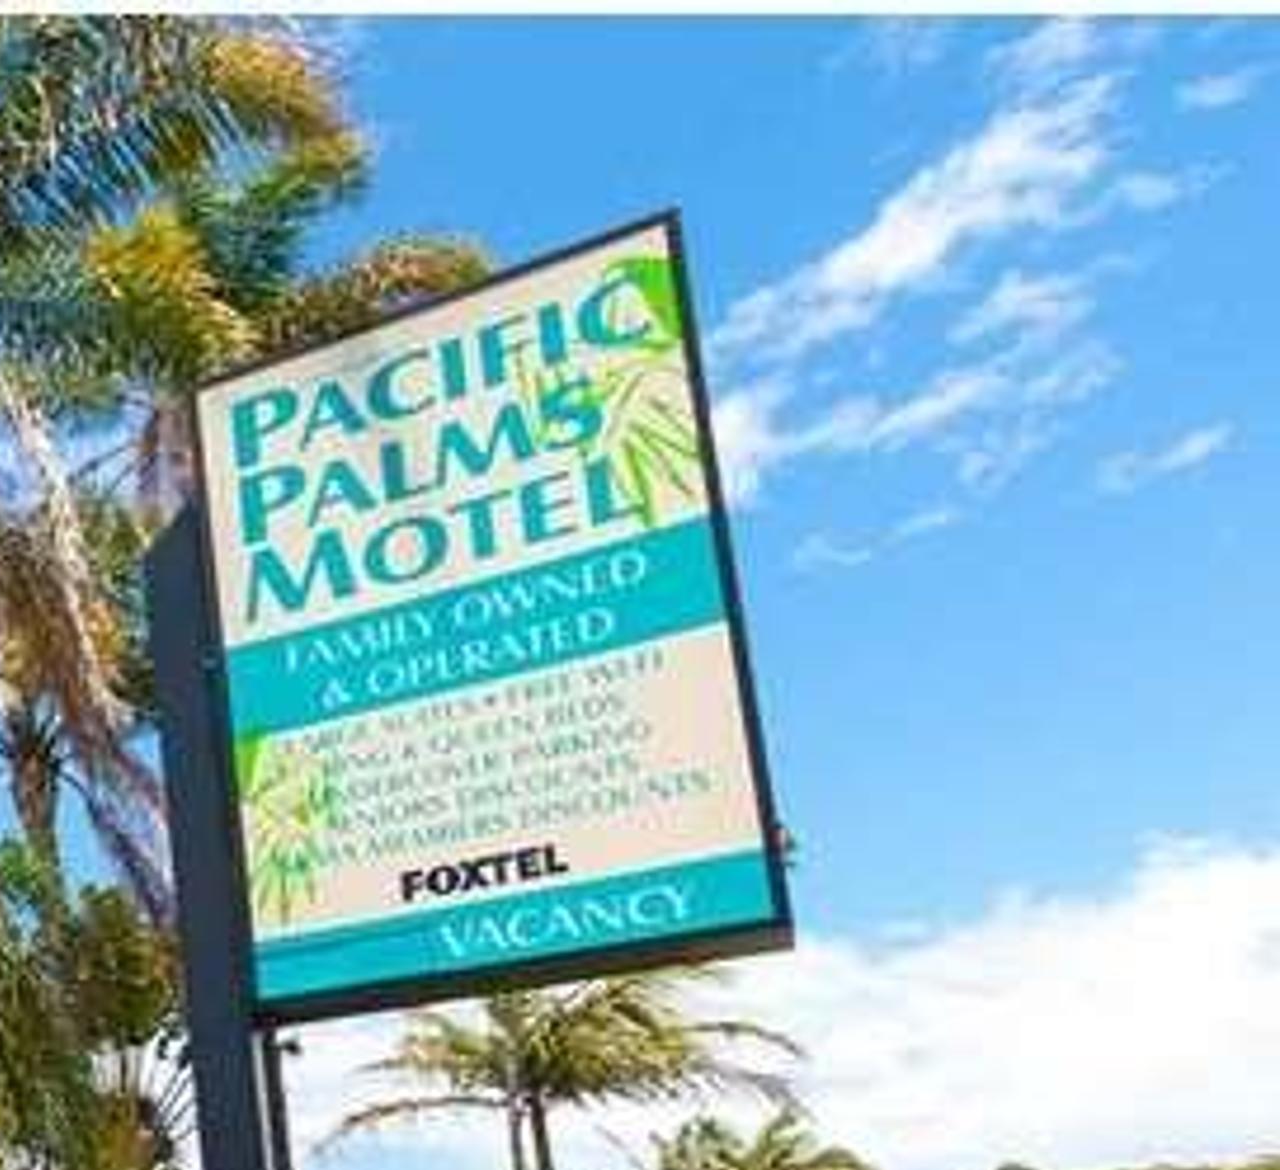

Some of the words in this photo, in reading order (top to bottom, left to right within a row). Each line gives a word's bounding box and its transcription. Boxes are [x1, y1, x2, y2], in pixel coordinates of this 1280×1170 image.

[228, 270, 654, 467] PACIFIC
[240, 373, 605, 545] PALMS
[246, 452, 643, 623] MOTEL
[285, 604, 437, 672] FAMILY
[451, 553, 647, 630] OWNED
[367, 607, 616, 695] OPERATED
[399, 844, 570, 901] FOXTEL
[443, 883, 694, 957] VACANCY
